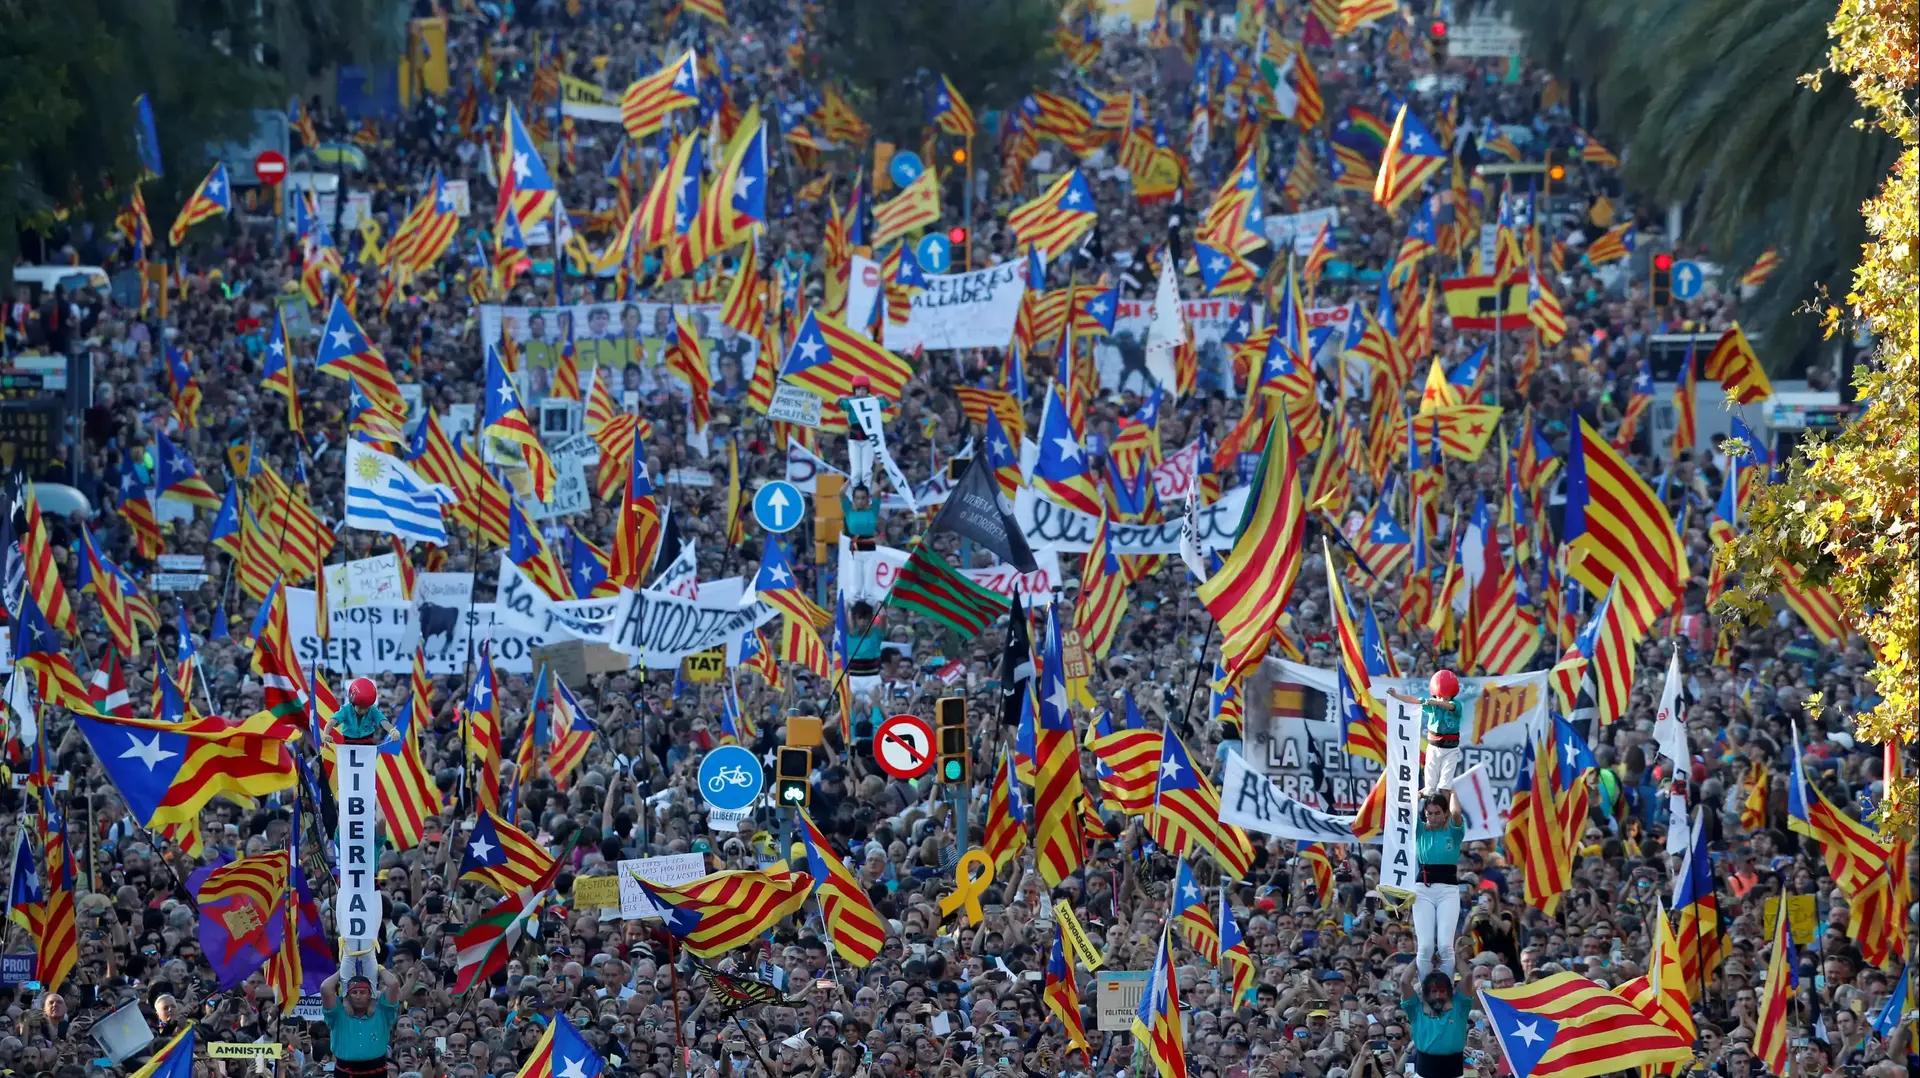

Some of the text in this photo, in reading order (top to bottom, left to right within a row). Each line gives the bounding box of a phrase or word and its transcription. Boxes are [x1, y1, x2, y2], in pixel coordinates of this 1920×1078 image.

[300, 636, 361, 661] SER
[689, 657, 721, 671] TAT
[1393, 705, 1412, 887] LLIBERTAT
[348, 750, 367, 936] LIBERTAD
[3, 958, 31, 972] PROU
[299, 1008, 321, 1016] TALK!
[216, 1046, 275, 1055] AMNISTIA
